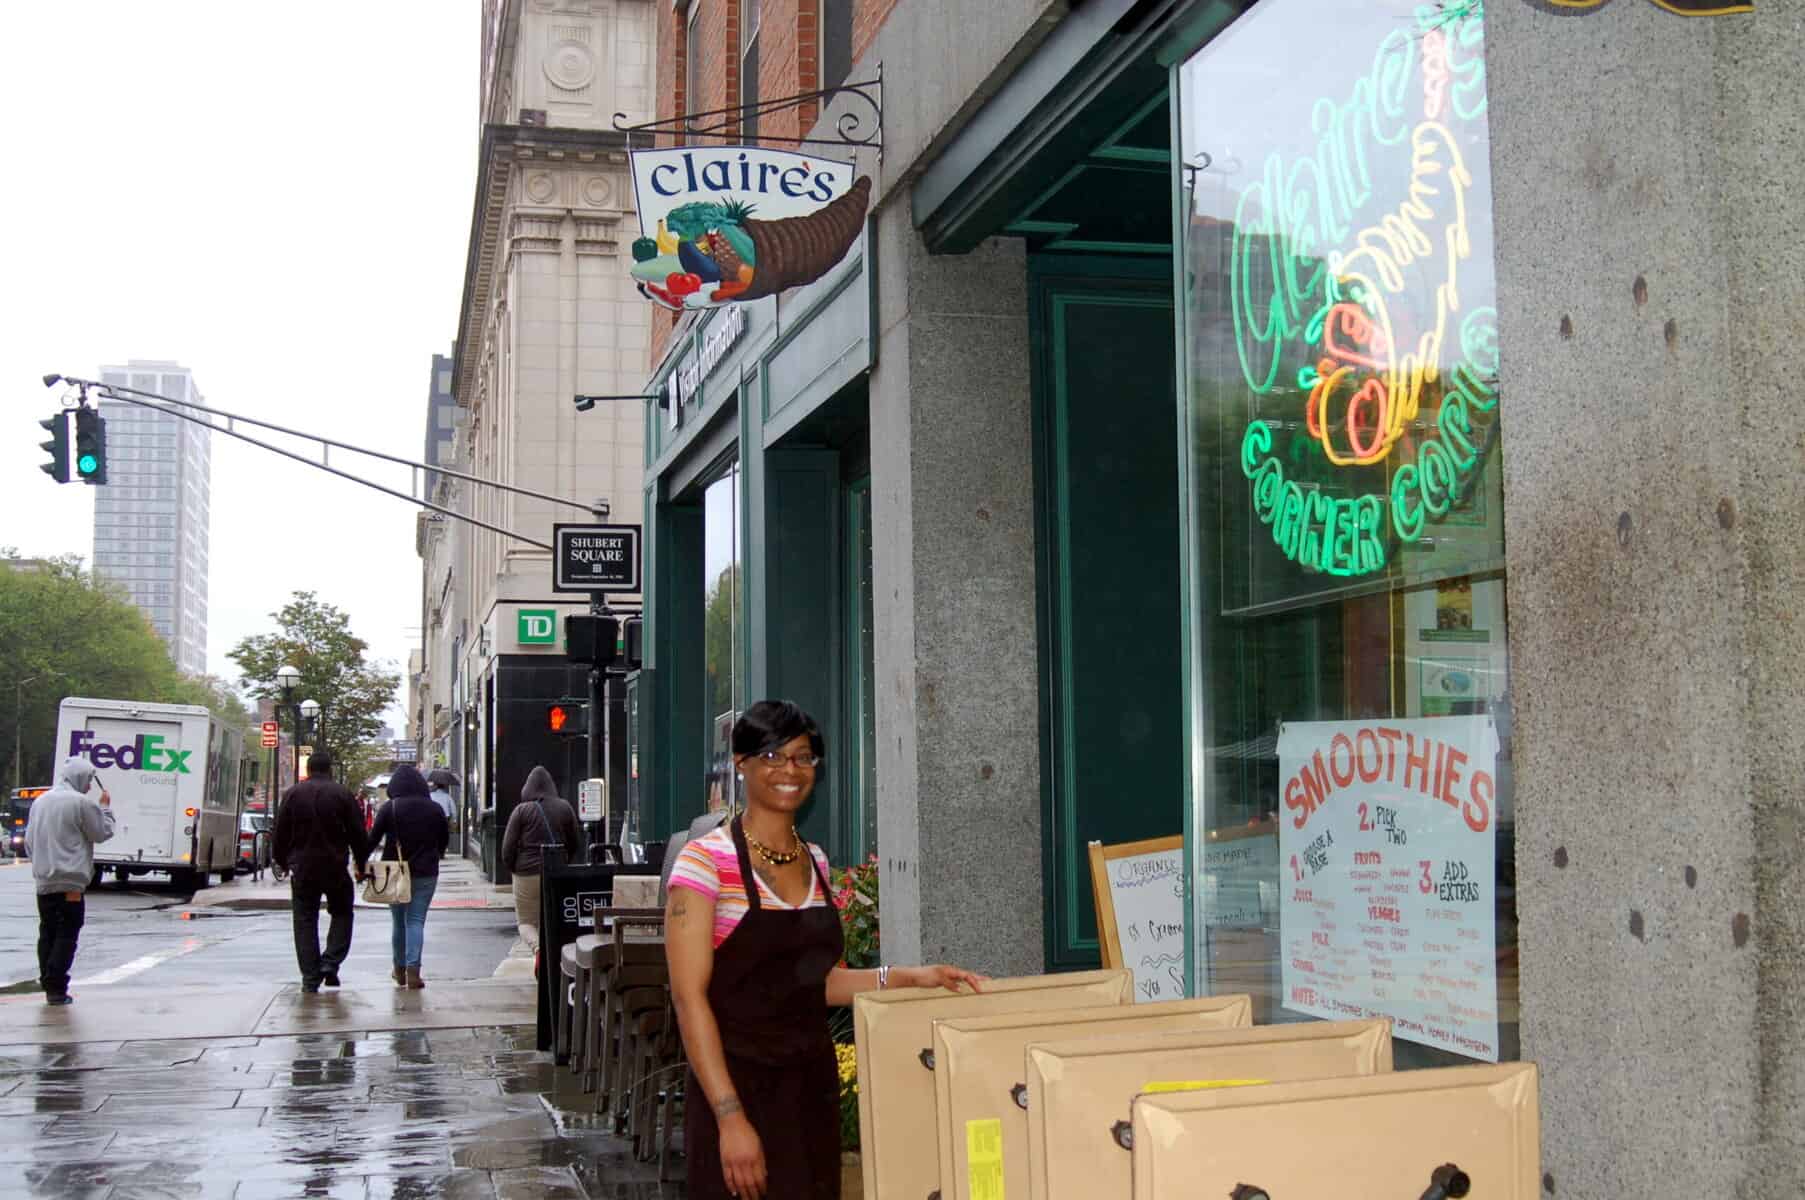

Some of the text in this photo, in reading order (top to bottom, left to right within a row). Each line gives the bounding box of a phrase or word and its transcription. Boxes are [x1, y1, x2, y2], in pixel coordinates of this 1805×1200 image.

[570, 538, 624, 549] SHUBERT
[570, 550, 624, 563] SQUARE
[521, 616, 552, 637] TD
[69, 730, 192, 774] FedEx
[1285, 726, 1494, 833] SMOOTHIES
[1384, 828, 1407, 846] TWO
[1442, 861, 1469, 881] ADD
[1439, 882, 1480, 902] EXTRAS
